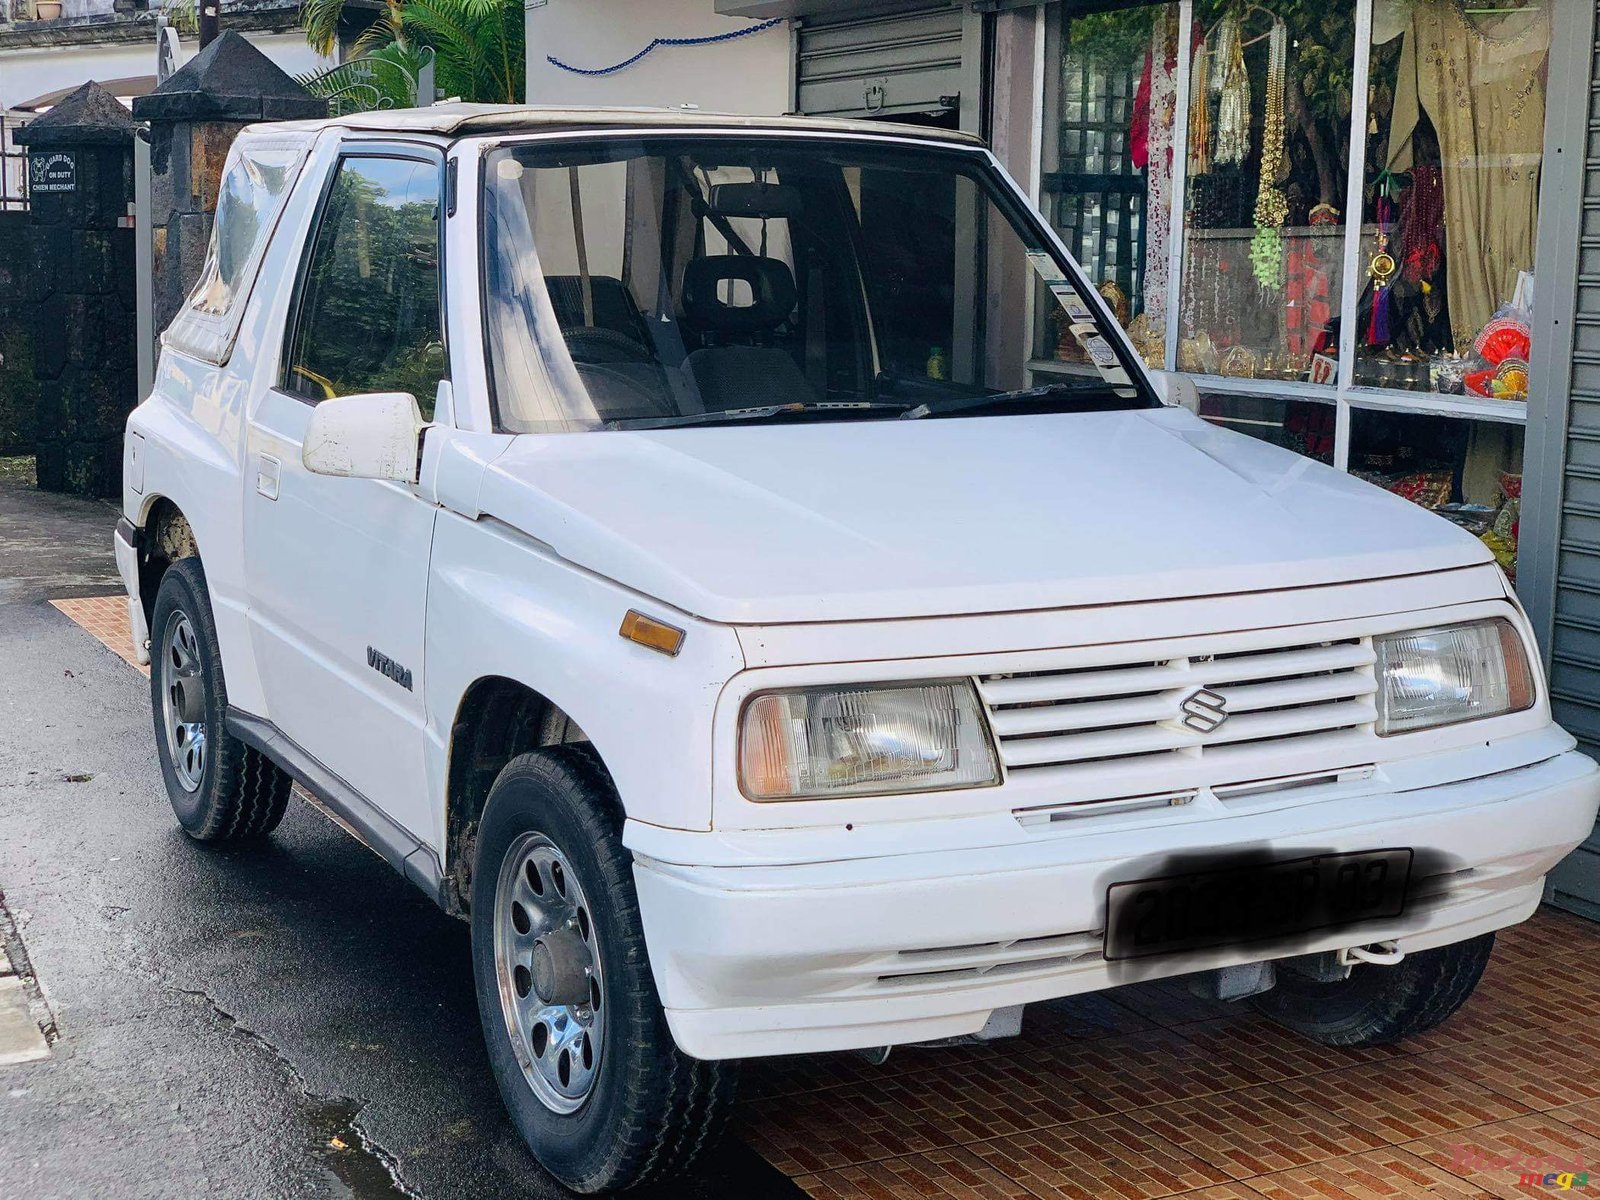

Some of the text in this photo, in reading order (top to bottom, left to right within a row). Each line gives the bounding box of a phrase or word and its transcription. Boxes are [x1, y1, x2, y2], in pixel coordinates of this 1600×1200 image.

[45, 154, 74, 169] GUARD DOG
[367, 645, 414, 693] VITARA
